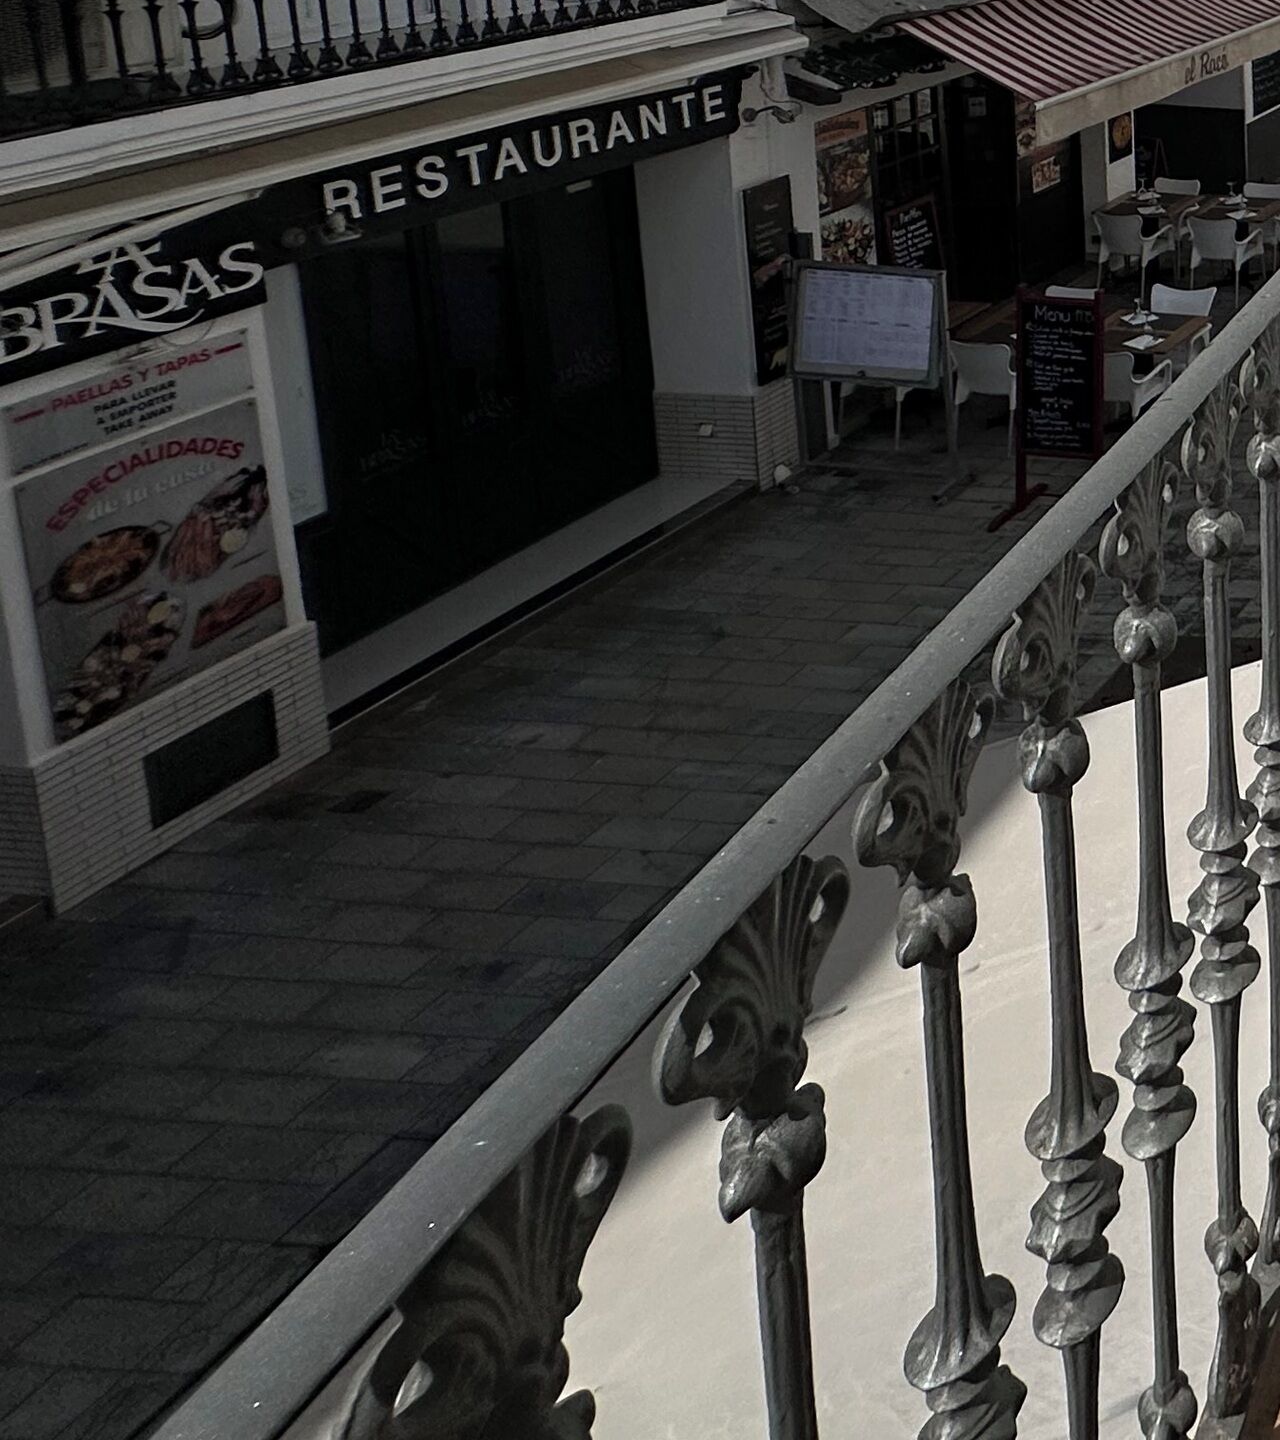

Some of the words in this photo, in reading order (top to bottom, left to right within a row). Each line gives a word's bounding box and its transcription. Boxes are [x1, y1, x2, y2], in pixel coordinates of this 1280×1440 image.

[1185, 54, 1197, 85] el
[1199, 46, 1230, 78] Racó
[322, 82, 728, 220] RESTAURANTE
[0, 240, 265, 365] BRASAS
[51, 373, 133, 414] PAELLAS
[137, 367, 149, 383] Y
[155, 348, 211, 376] TAPAS
[94, 396, 127, 414] PARA
[132, 379, 176, 401] LLEVAR
[96, 417, 106, 426] A
[109, 391, 177, 420] EMPORTER
[103, 417, 133, 436] TAKE
[140, 404, 174, 422] AWAY
[45, 436, 246, 534] ESPECIALIDADES
